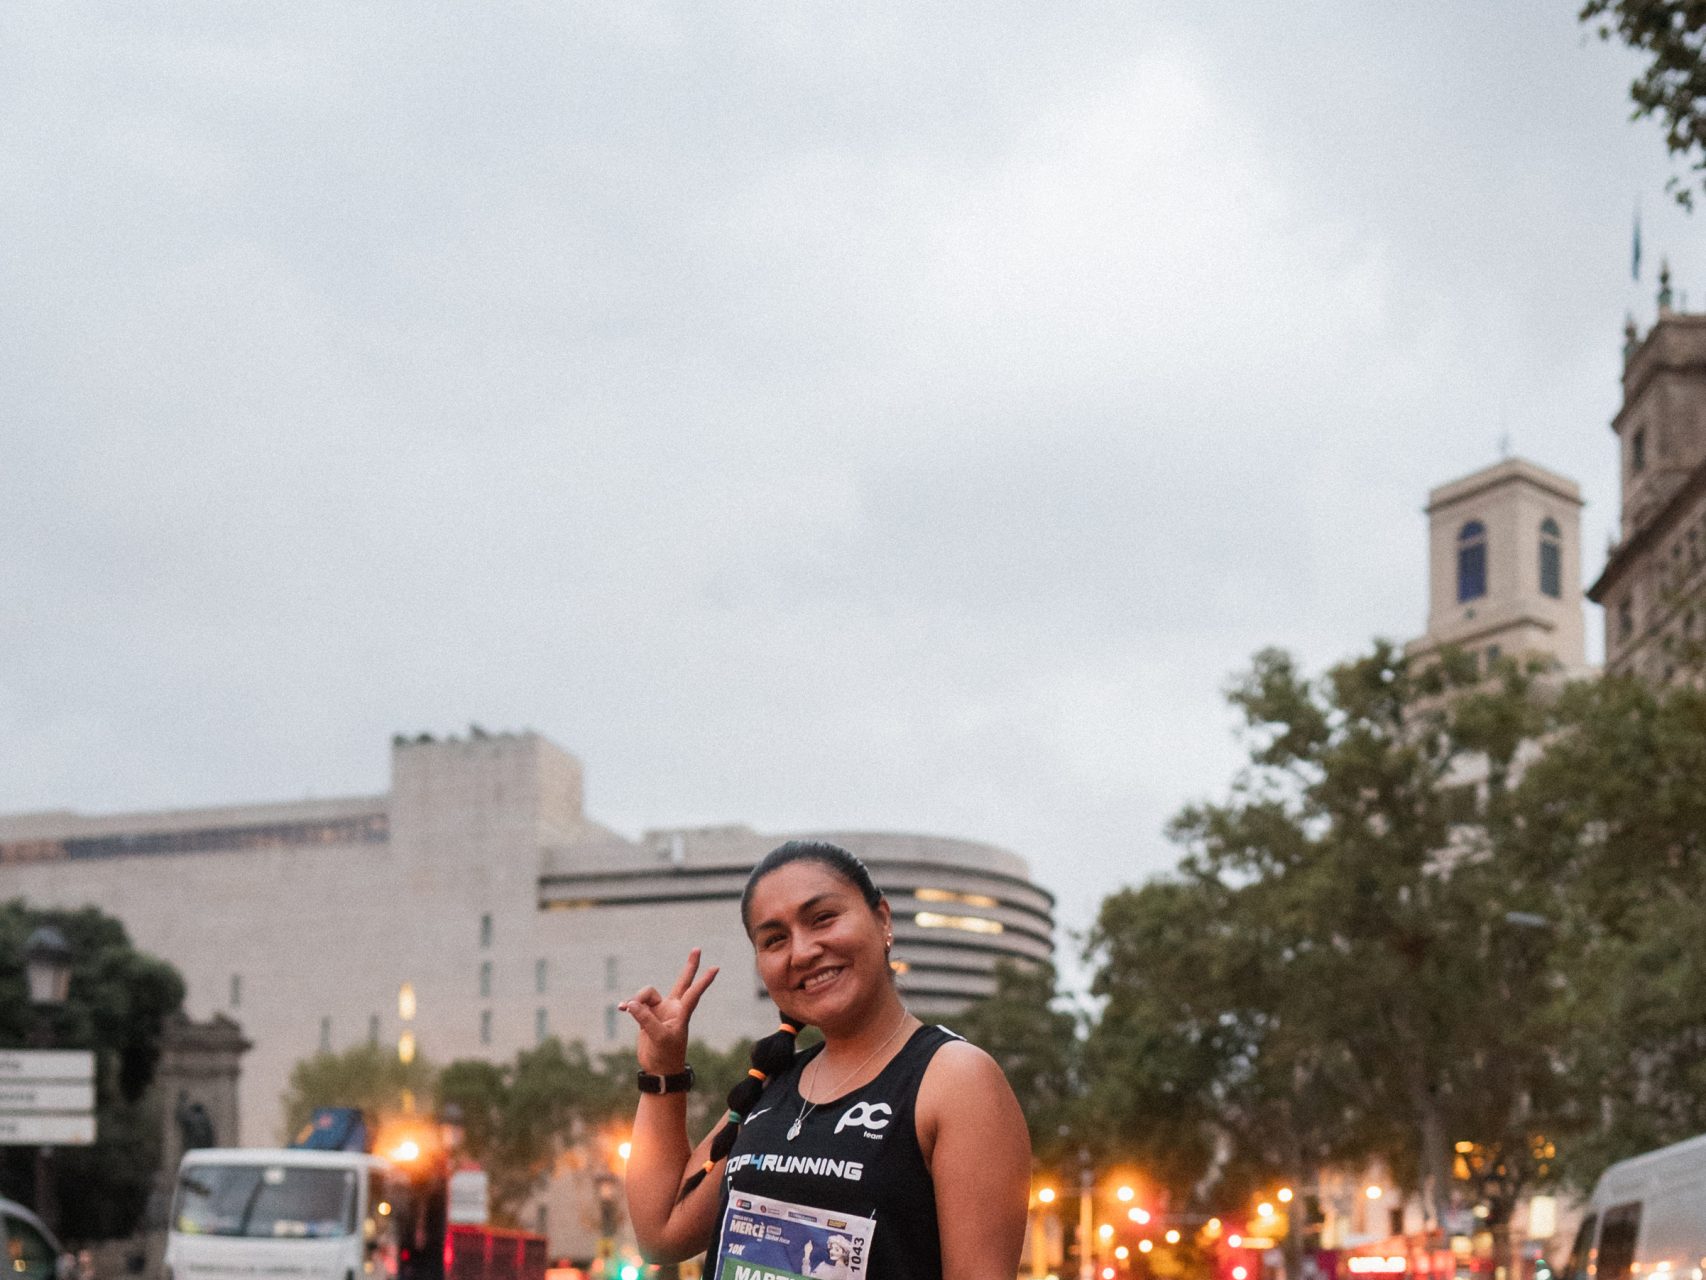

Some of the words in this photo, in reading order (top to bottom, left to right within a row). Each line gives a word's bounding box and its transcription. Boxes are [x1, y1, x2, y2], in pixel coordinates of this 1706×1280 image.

[863, 1131, 883, 1140] team
[728, 1242, 746, 1256] 10K
[850, 1237, 865, 1273] 1043
